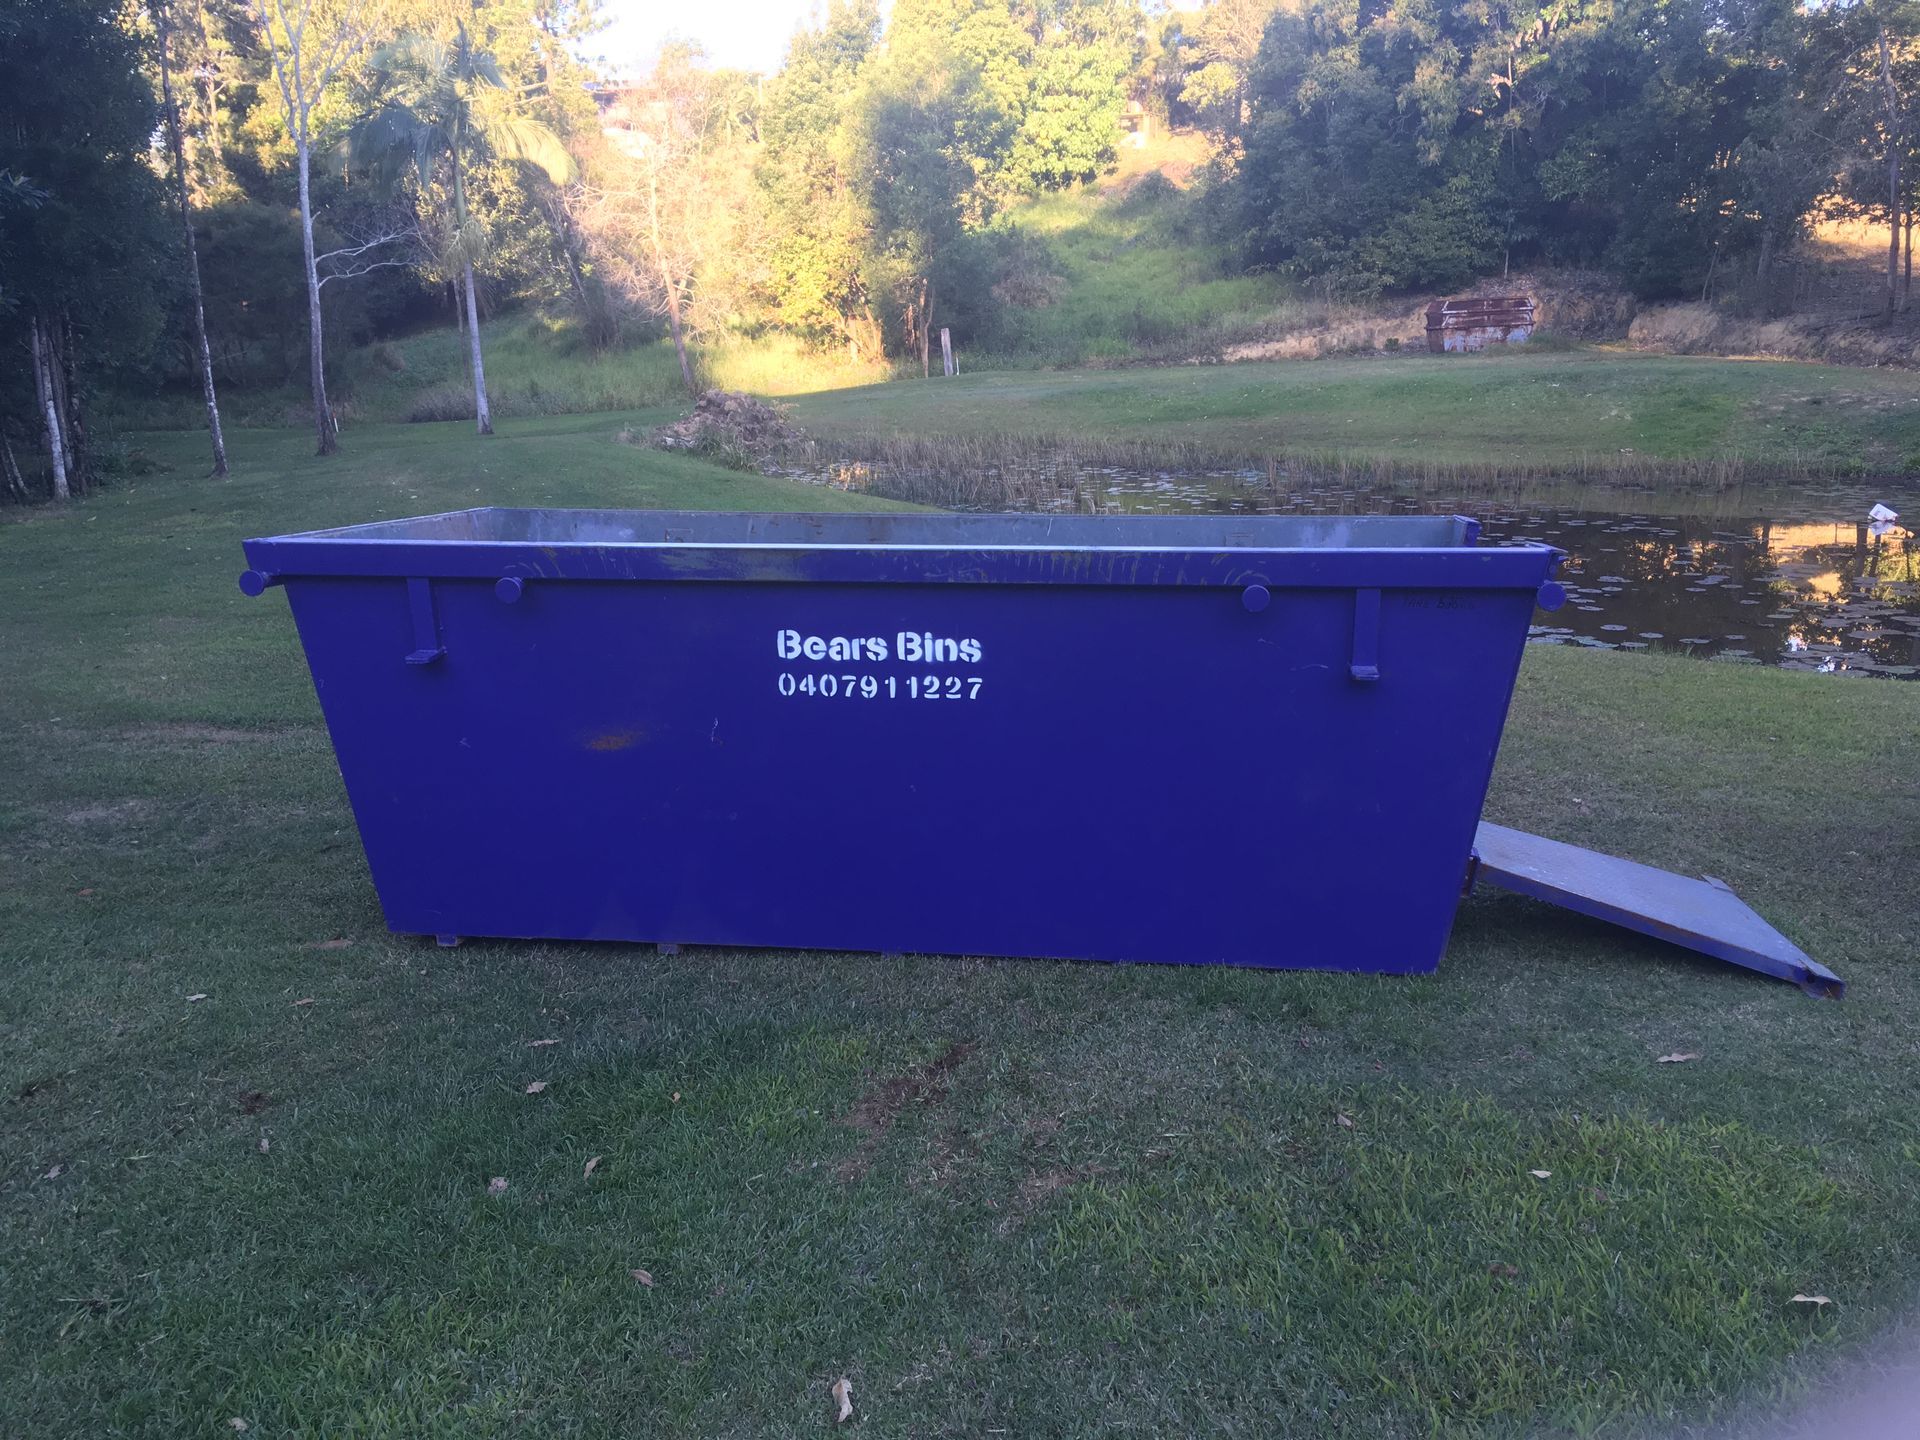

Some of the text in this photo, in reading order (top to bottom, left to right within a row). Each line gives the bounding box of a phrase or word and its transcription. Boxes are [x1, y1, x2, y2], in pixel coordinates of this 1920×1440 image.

[776, 629, 982, 663] Bears Bins
[778, 672, 983, 700] 0407911227
